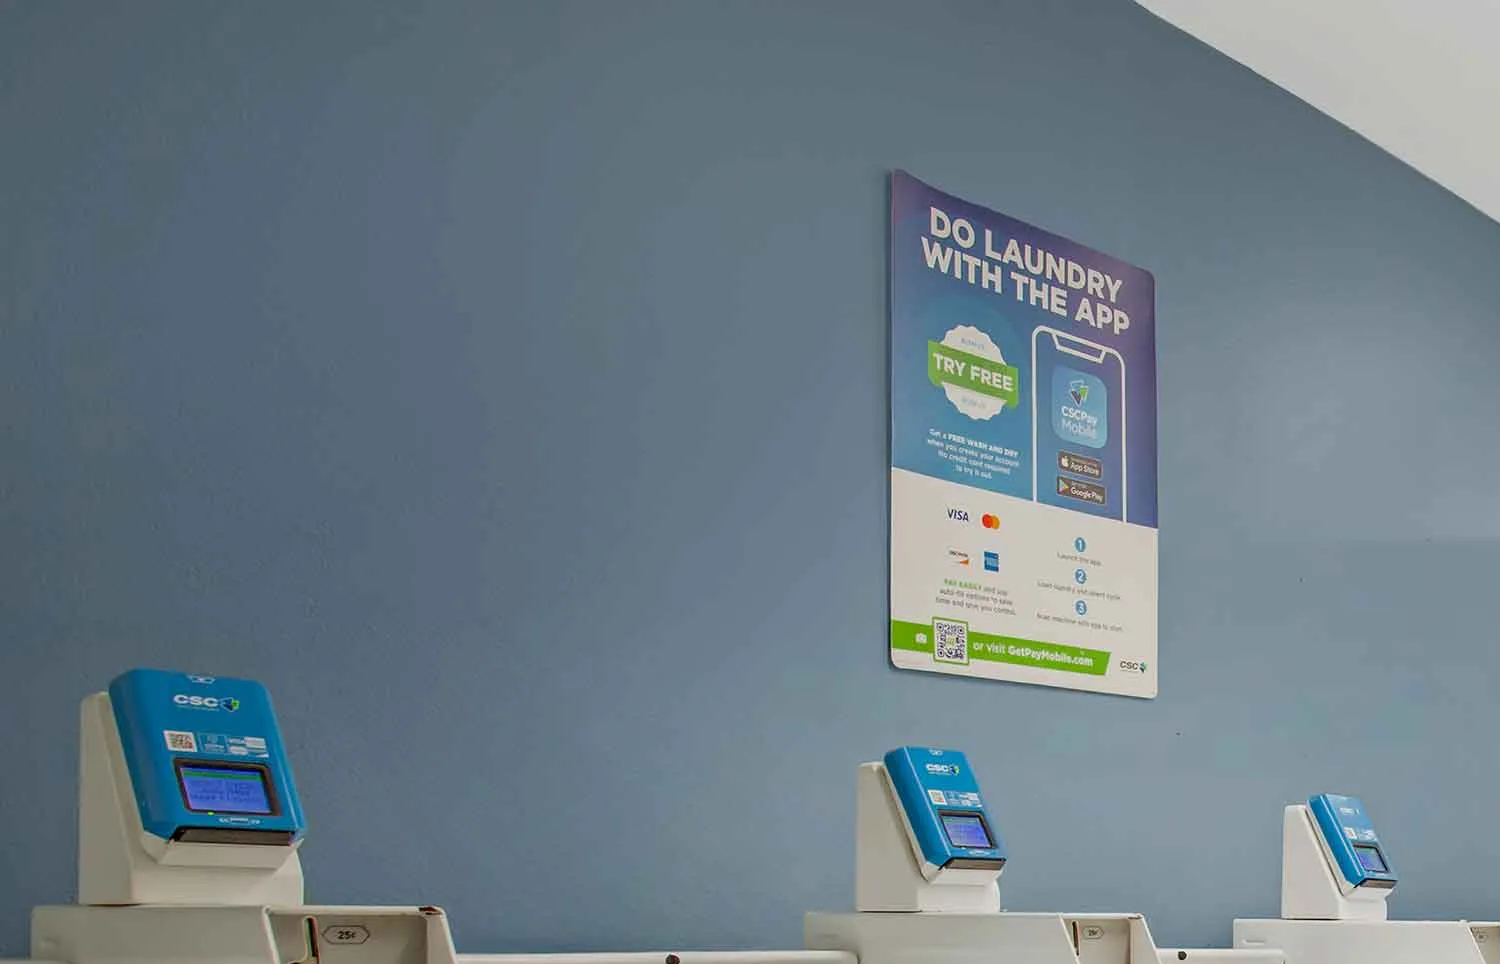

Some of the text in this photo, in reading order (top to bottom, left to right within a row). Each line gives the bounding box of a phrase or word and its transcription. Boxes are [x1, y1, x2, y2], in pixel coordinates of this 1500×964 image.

[930, 206, 1123, 303] DO LAUNDRY
[920, 236, 1131, 335] WITH THE APP
[932, 352, 1014, 392] TRY FREE
[946, 509, 970, 522] VISA
[973, 642, 1094, 668] or visit GetPayMobile.com
[1120, 660, 1139, 671] CSC
[173, 694, 219, 708] CSC
